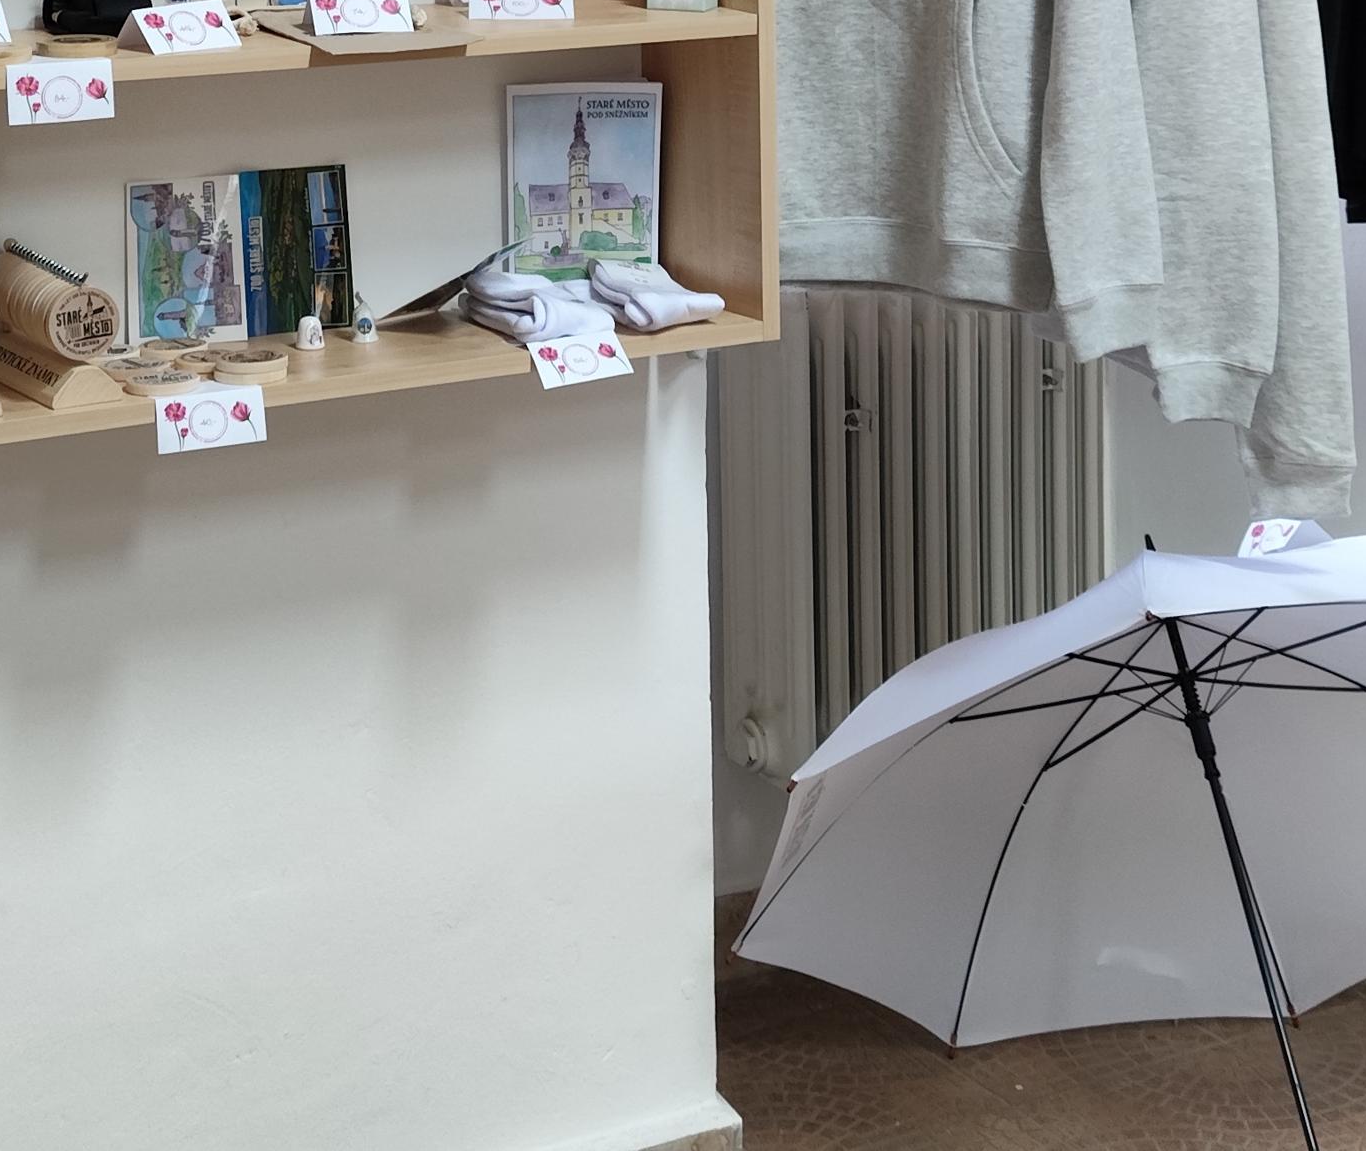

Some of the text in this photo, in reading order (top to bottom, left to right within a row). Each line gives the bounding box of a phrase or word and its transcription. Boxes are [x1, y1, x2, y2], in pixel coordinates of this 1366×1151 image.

[586, 99, 614, 110] STARÉ
[587, 111, 604, 119] POD
[56, 306, 84, 328] STARÉ
[83, 319, 110, 337] MĚSTO
